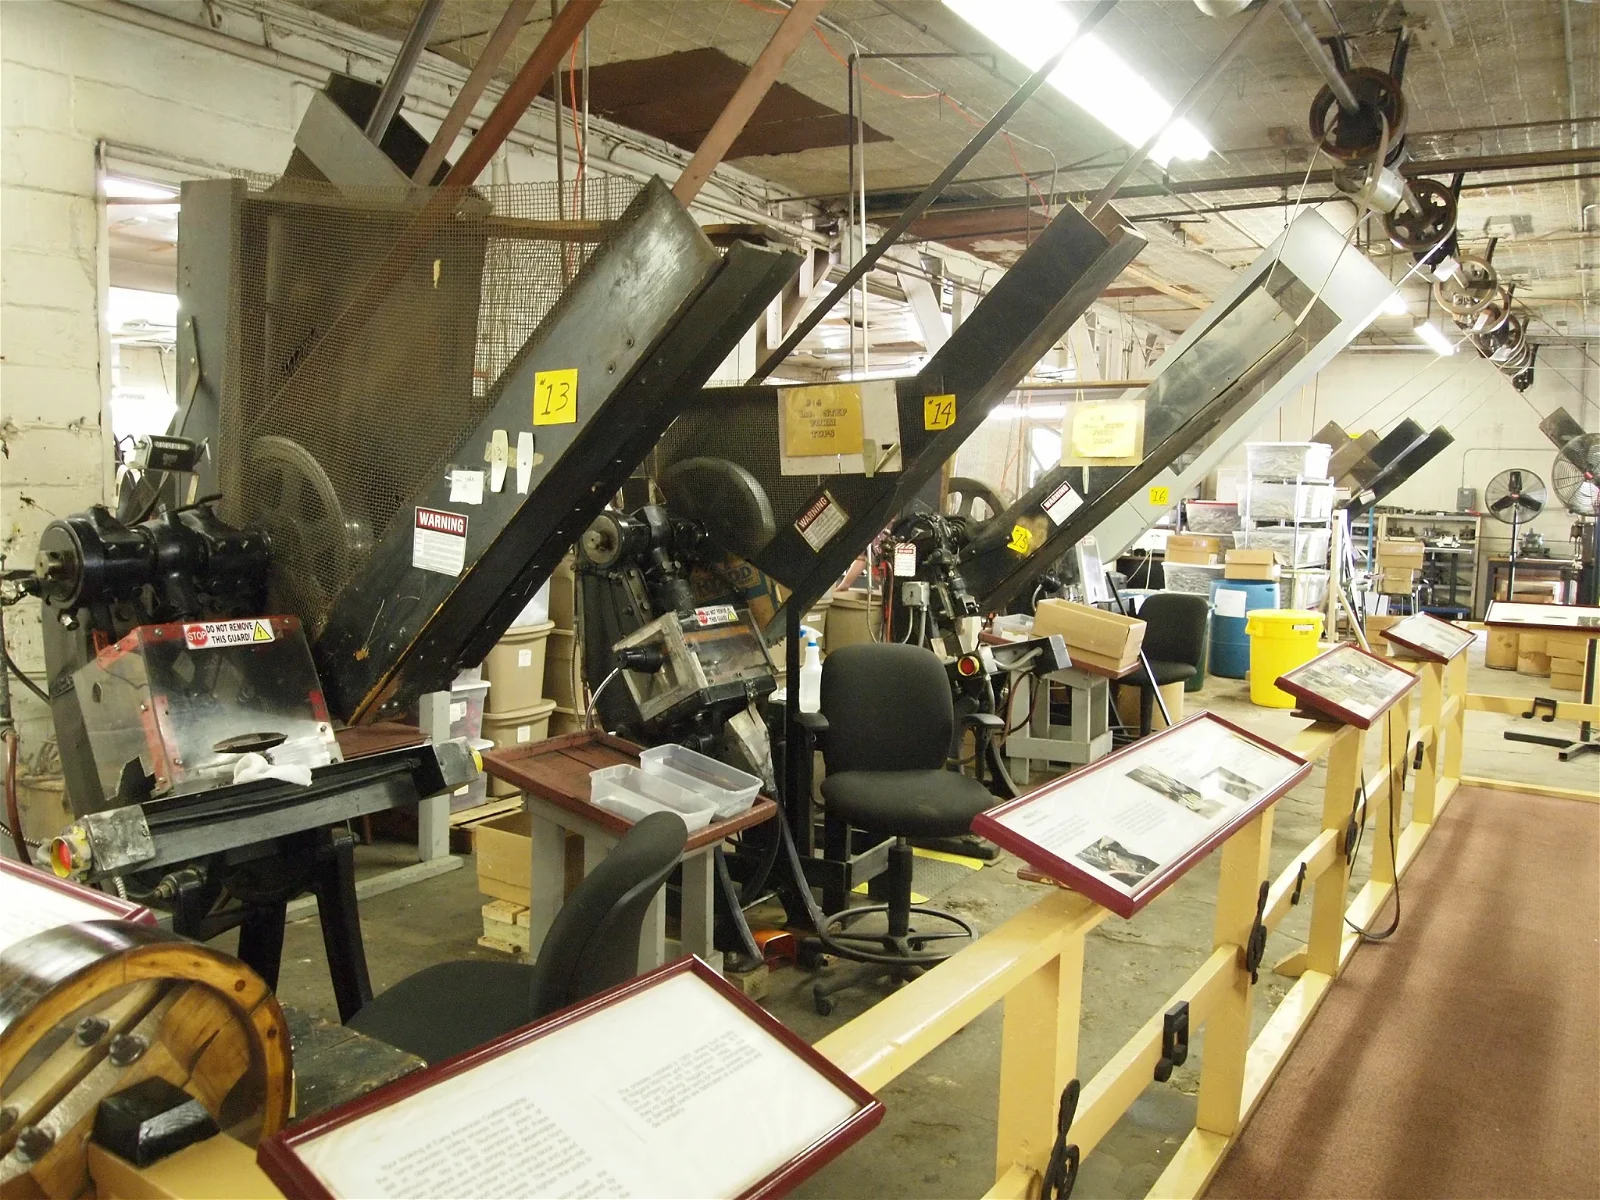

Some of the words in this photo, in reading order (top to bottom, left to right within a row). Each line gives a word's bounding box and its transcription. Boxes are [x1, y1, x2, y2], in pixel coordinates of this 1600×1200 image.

[823, 408, 847, 418] STEP
[810, 429, 835, 438] TOPS
[798, 496, 828, 528] WARNING
[419, 511, 464, 533] WARNING
[206, 625, 215, 633] DO
[216, 624, 228, 633] NOT
[229, 622, 253, 632] REMOVE
[187, 630, 207, 641] STOP
[211, 635, 226, 645] THIS
